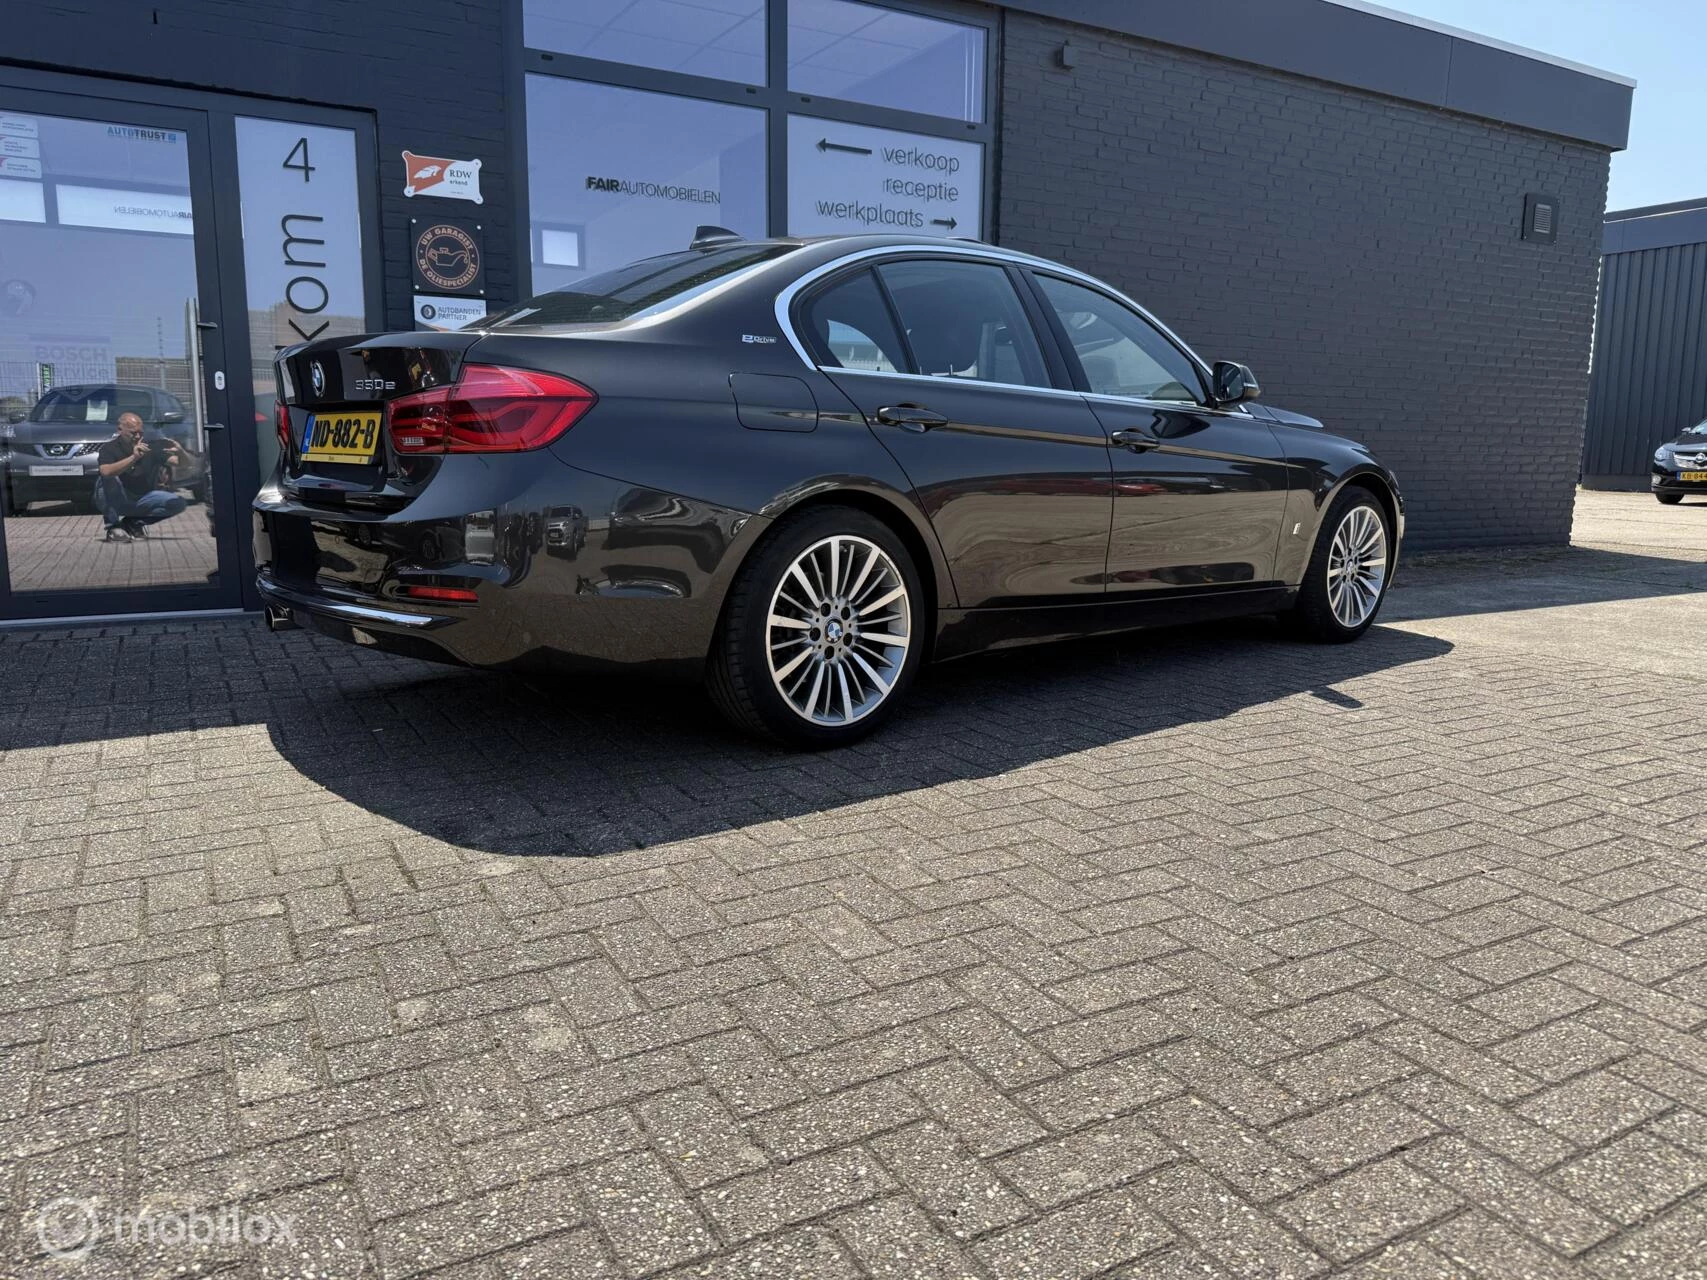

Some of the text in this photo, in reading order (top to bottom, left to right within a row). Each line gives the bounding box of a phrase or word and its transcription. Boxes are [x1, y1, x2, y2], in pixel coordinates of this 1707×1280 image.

[283, 137, 315, 182] 4
[880, 146, 960, 175] verkoop
[449, 169, 472, 179] RDW
[585, 176, 720, 204] FAIRAUTOMOBIELEN
[883, 177, 959, 202] receptie
[815, 199, 924, 228] werkplaats
[421, 228, 474, 249] UW GARAGIST
[275, 214, 329, 349] kom
[426, 263, 477, 287] OLIESPECIALIST
[438, 306, 481, 315] AUTOBANDEN
[438, 313, 467, 321] PARTNER
[311, 418, 376, 449] ND-882-B
